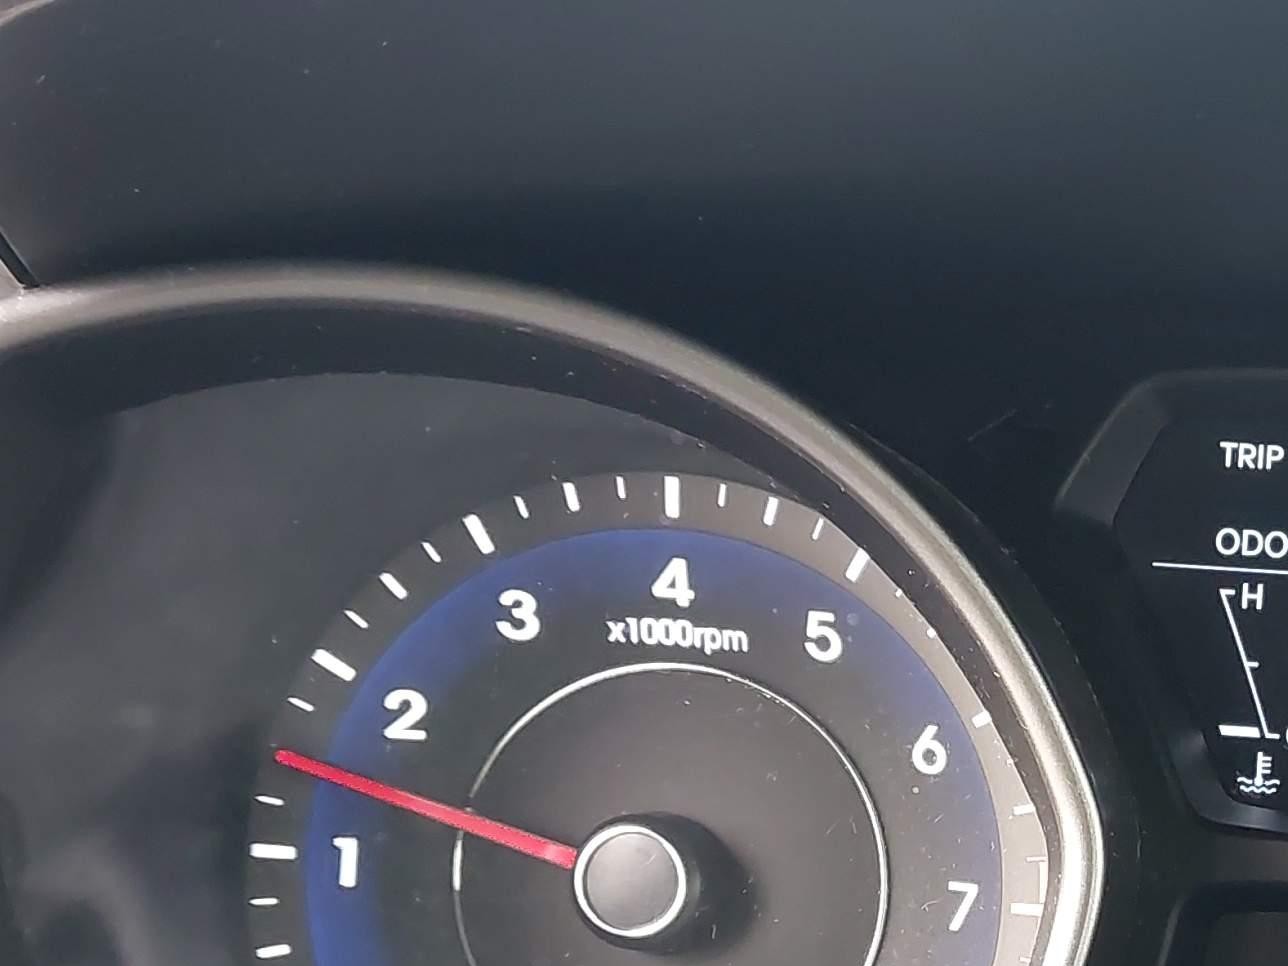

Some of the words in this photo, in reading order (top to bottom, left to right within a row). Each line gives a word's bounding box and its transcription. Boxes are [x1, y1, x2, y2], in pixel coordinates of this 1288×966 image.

[1219, 441, 1285, 470] TRIP
[651, 557, 696, 608] 4
[1241, 582, 1264, 610] H
[495, 589, 541, 642] 3
[606, 617, 749, 656] x1000rpm
[804, 610, 843, 662] 5
[383, 689, 428, 741] 2
[911, 724, 948, 775] 6
[333, 837, 359, 888] 1
[947, 880, 979, 932] 7
